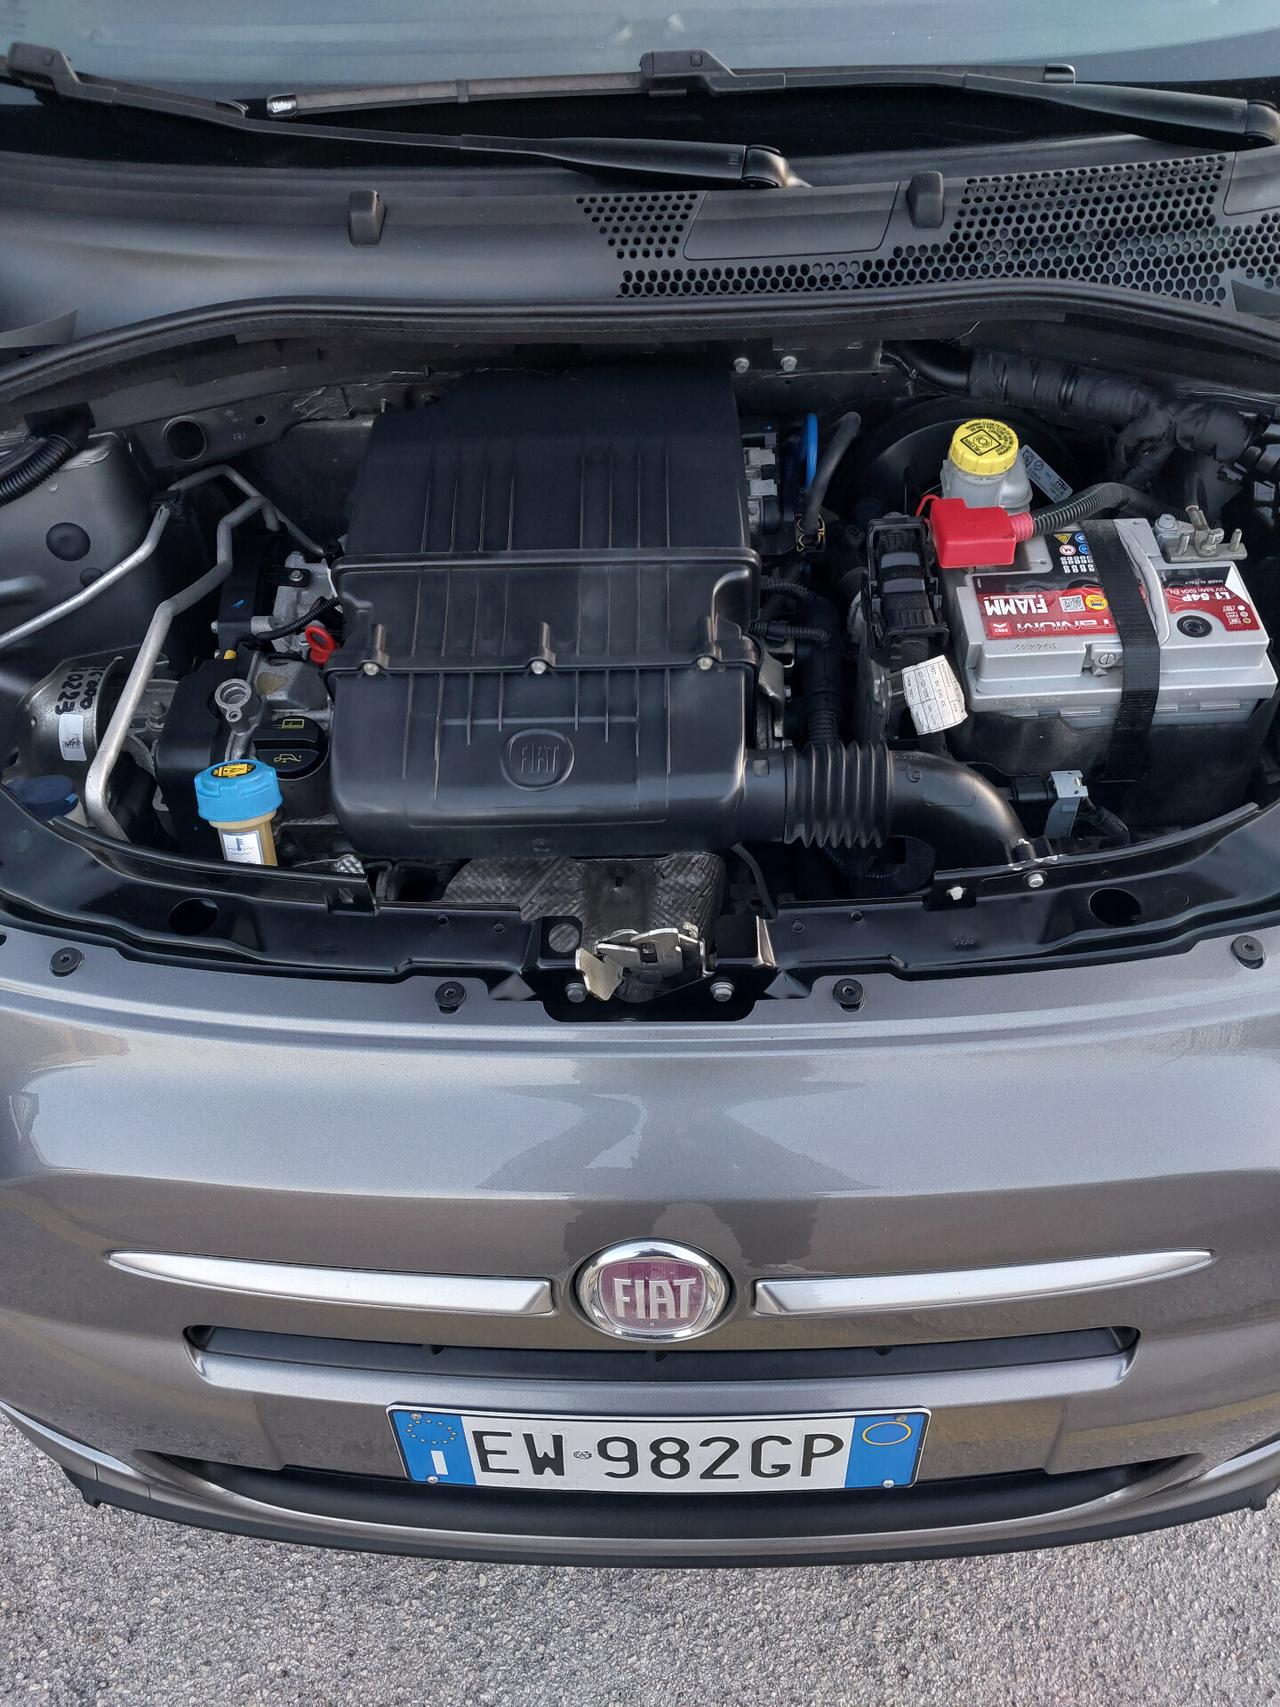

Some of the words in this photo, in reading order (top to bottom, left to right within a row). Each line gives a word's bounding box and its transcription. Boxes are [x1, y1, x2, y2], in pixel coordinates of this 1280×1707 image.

[983, 596, 1049, 616] FIAMM
[1182, 593, 1210, 602] 54P
[612, 1277, 696, 1321] FIAT
[471, 1430, 566, 1477] EW
[596, 1433, 845, 1480] 982GP
